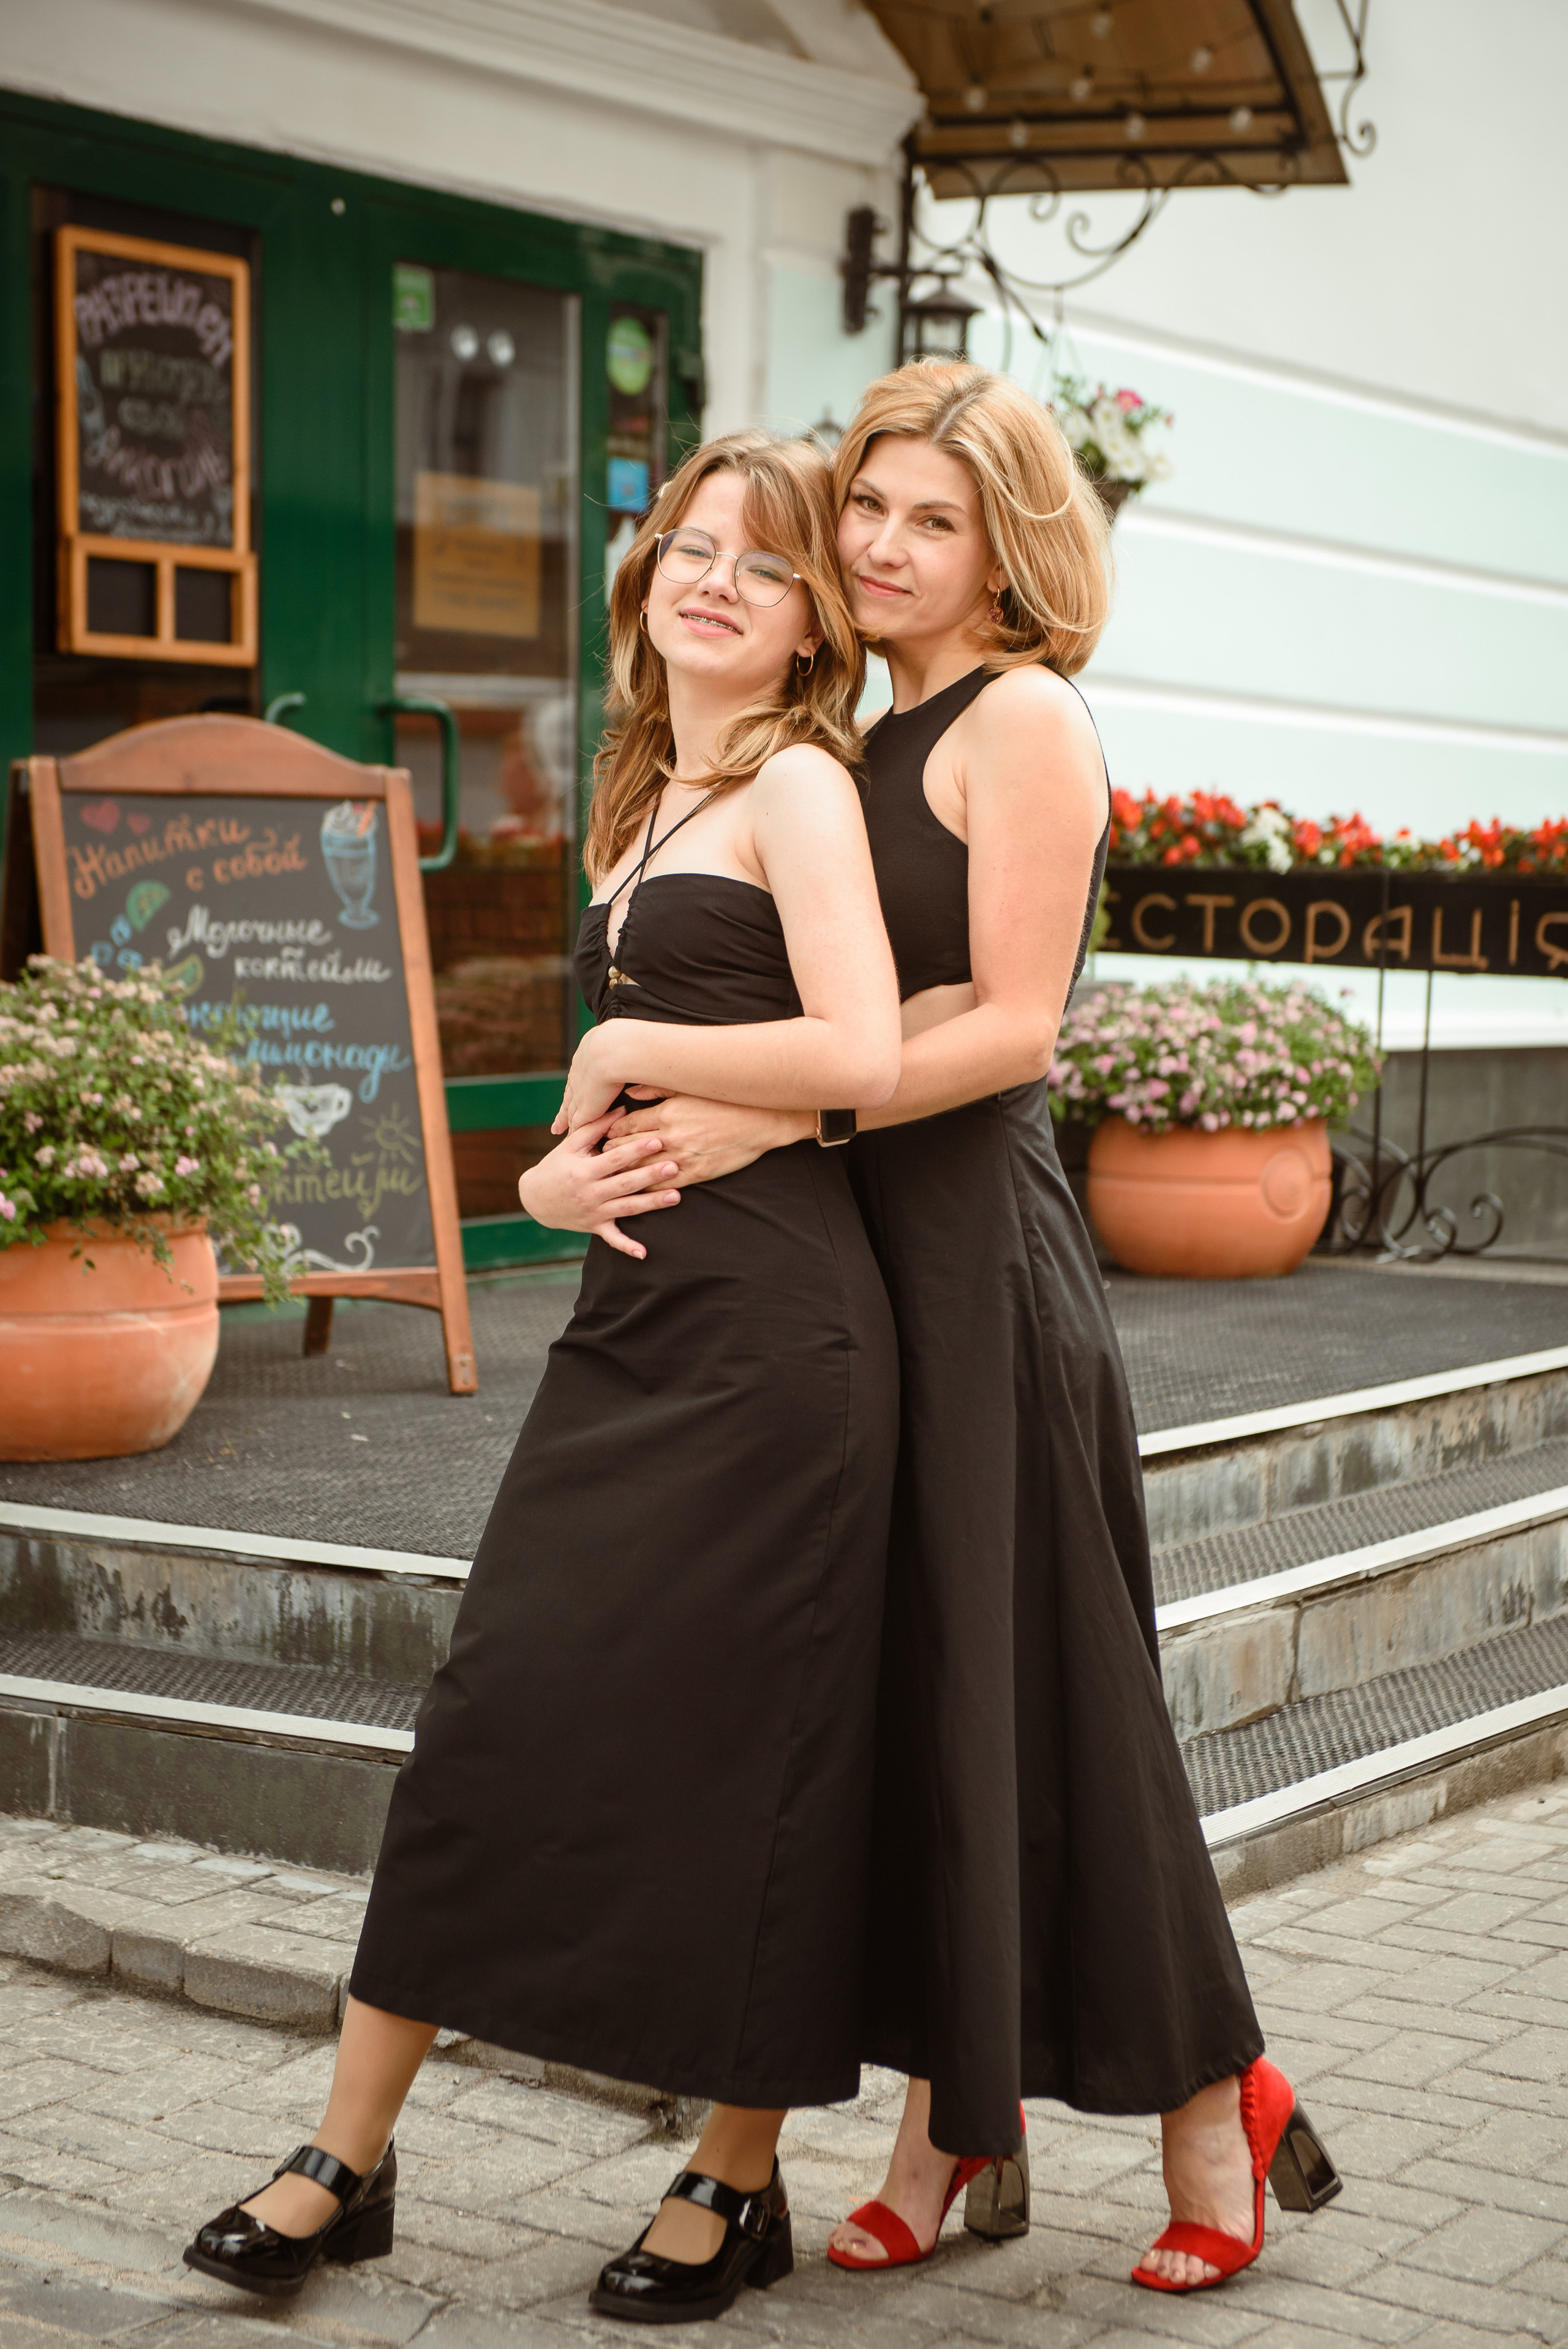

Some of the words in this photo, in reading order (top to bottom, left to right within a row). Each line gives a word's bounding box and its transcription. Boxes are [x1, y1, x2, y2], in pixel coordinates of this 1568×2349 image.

[67, 813, 252, 899] Напитки
[186, 865, 205, 893] с
[212, 820, 308, 885] собой
[165, 903, 334, 961] Молочные
[233, 945, 393, 986] коктейли
[1102, 891, 1568, 972] СТОРАЦІЯ
